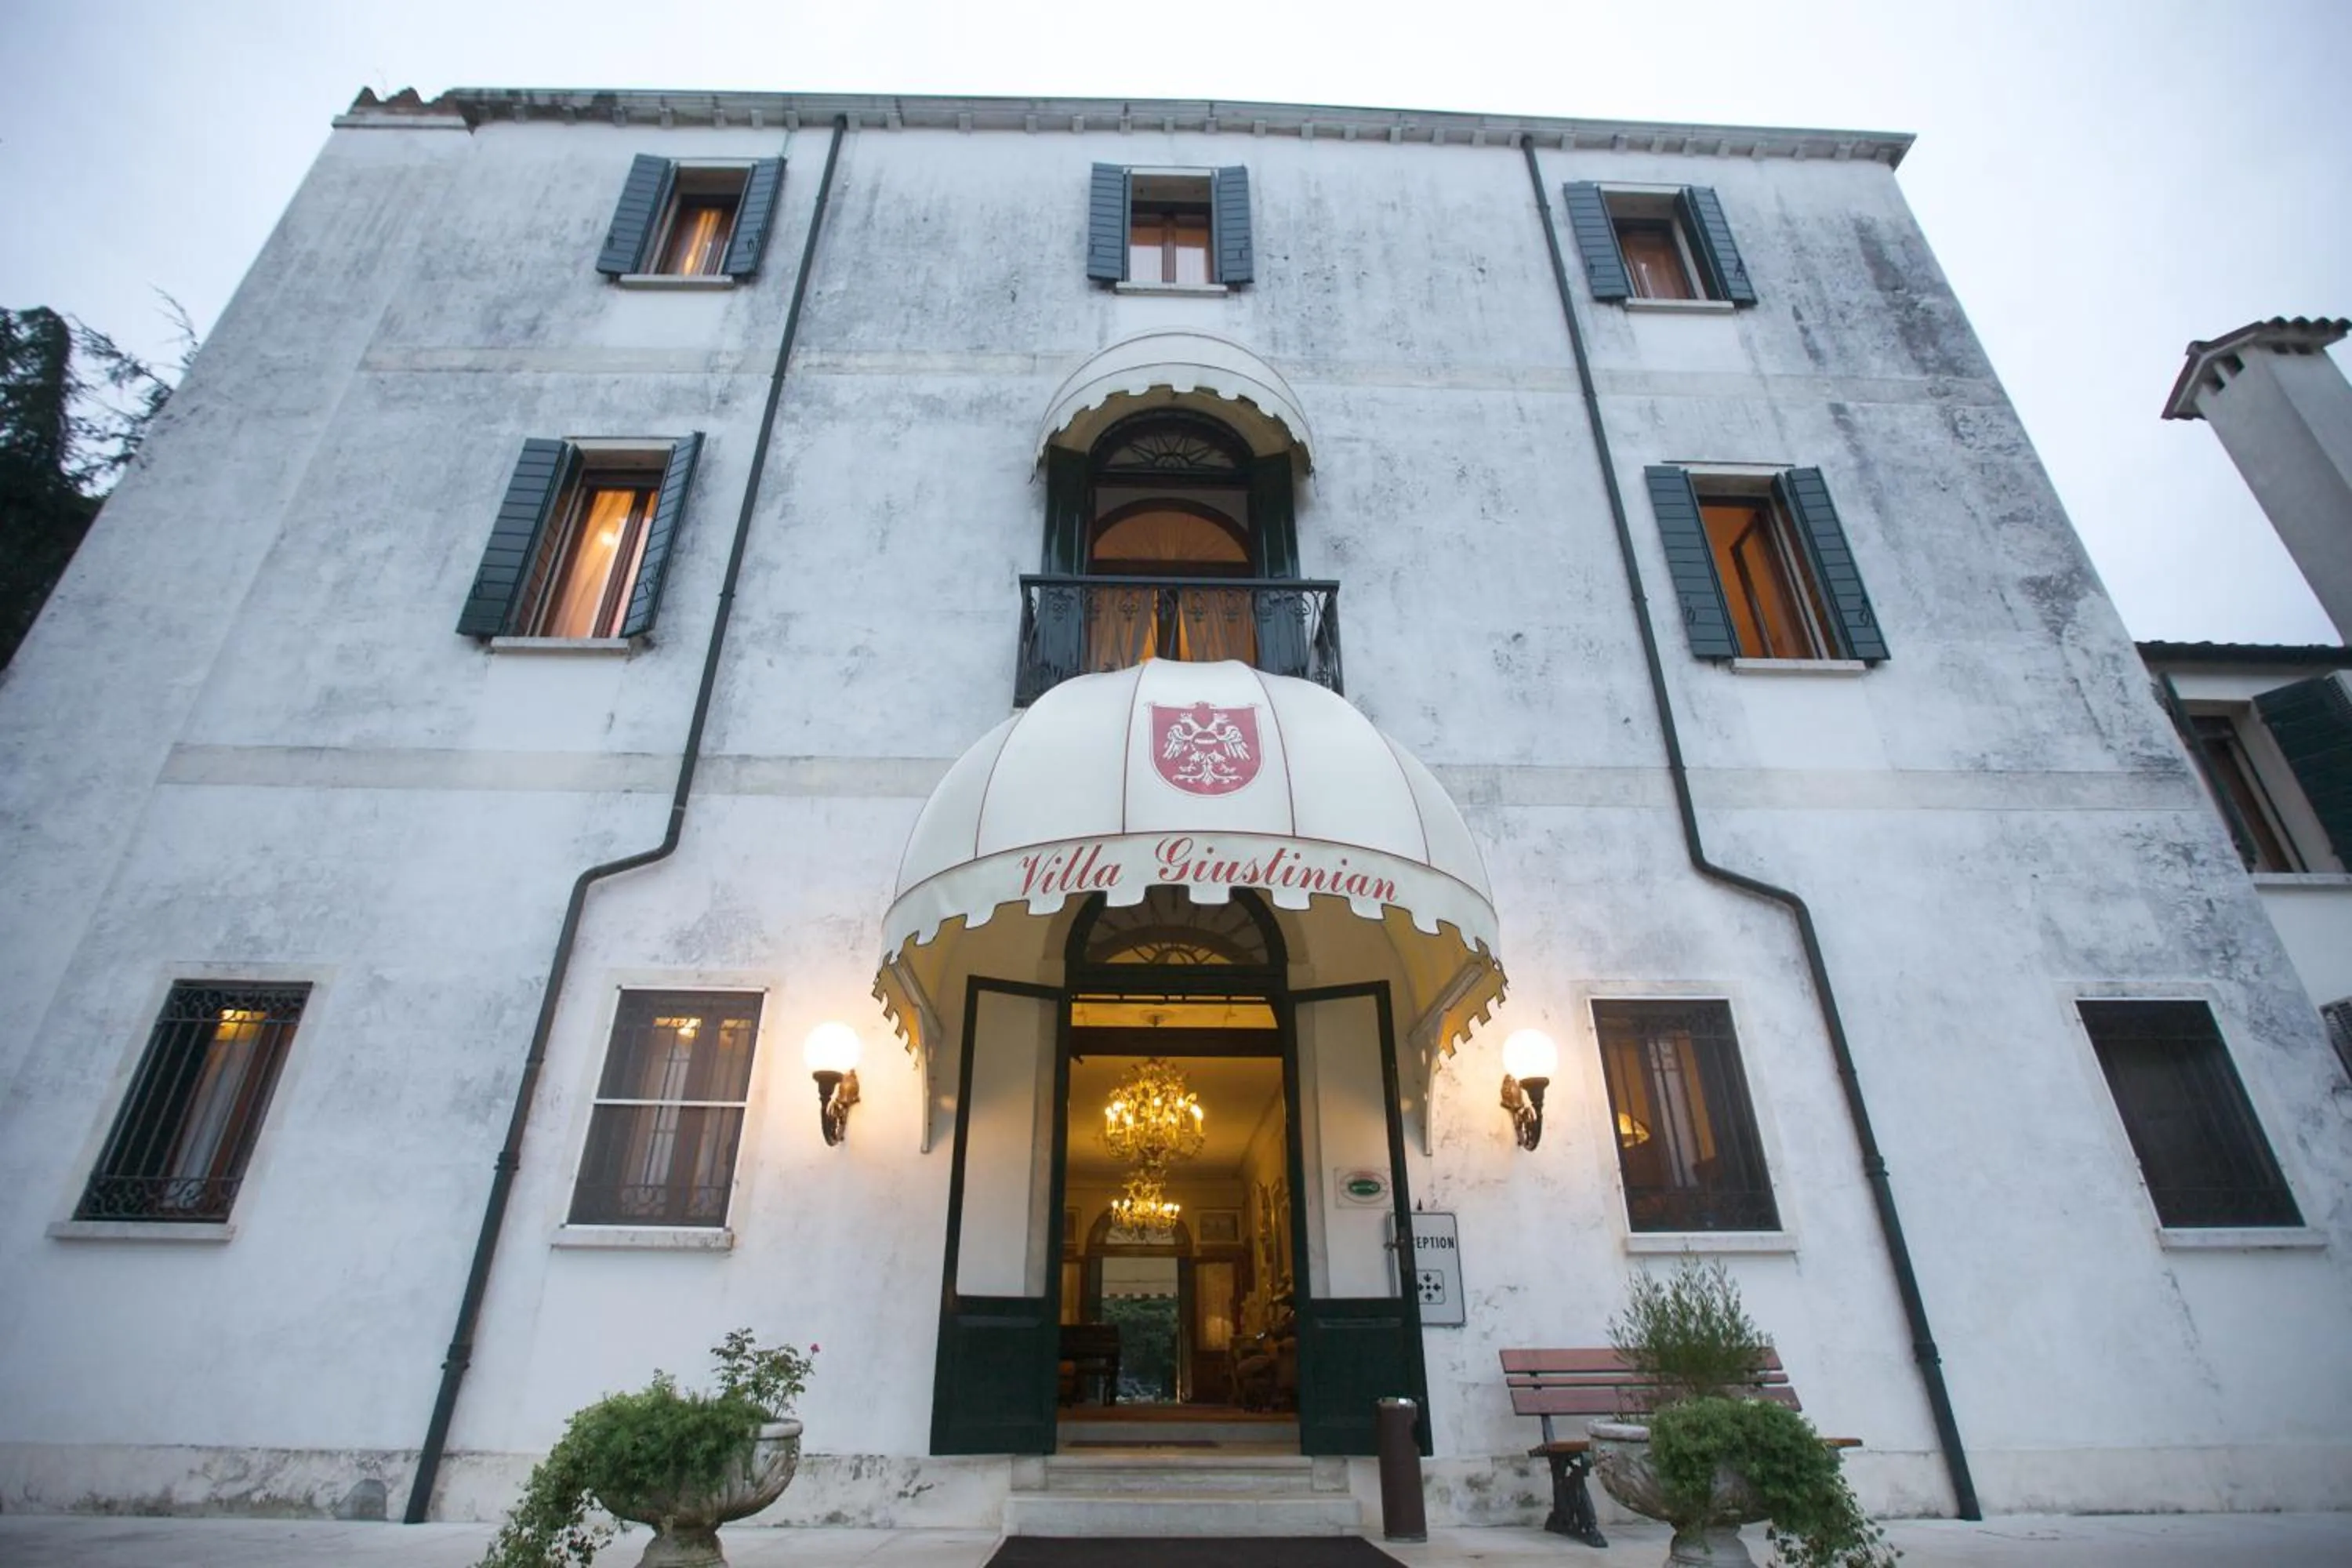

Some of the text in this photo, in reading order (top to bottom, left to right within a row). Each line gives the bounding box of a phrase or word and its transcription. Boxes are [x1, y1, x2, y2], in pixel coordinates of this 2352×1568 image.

[1019, 837, 1398, 902] Villa Giustinian
[1415, 1236, 1455, 1249] EPTION
